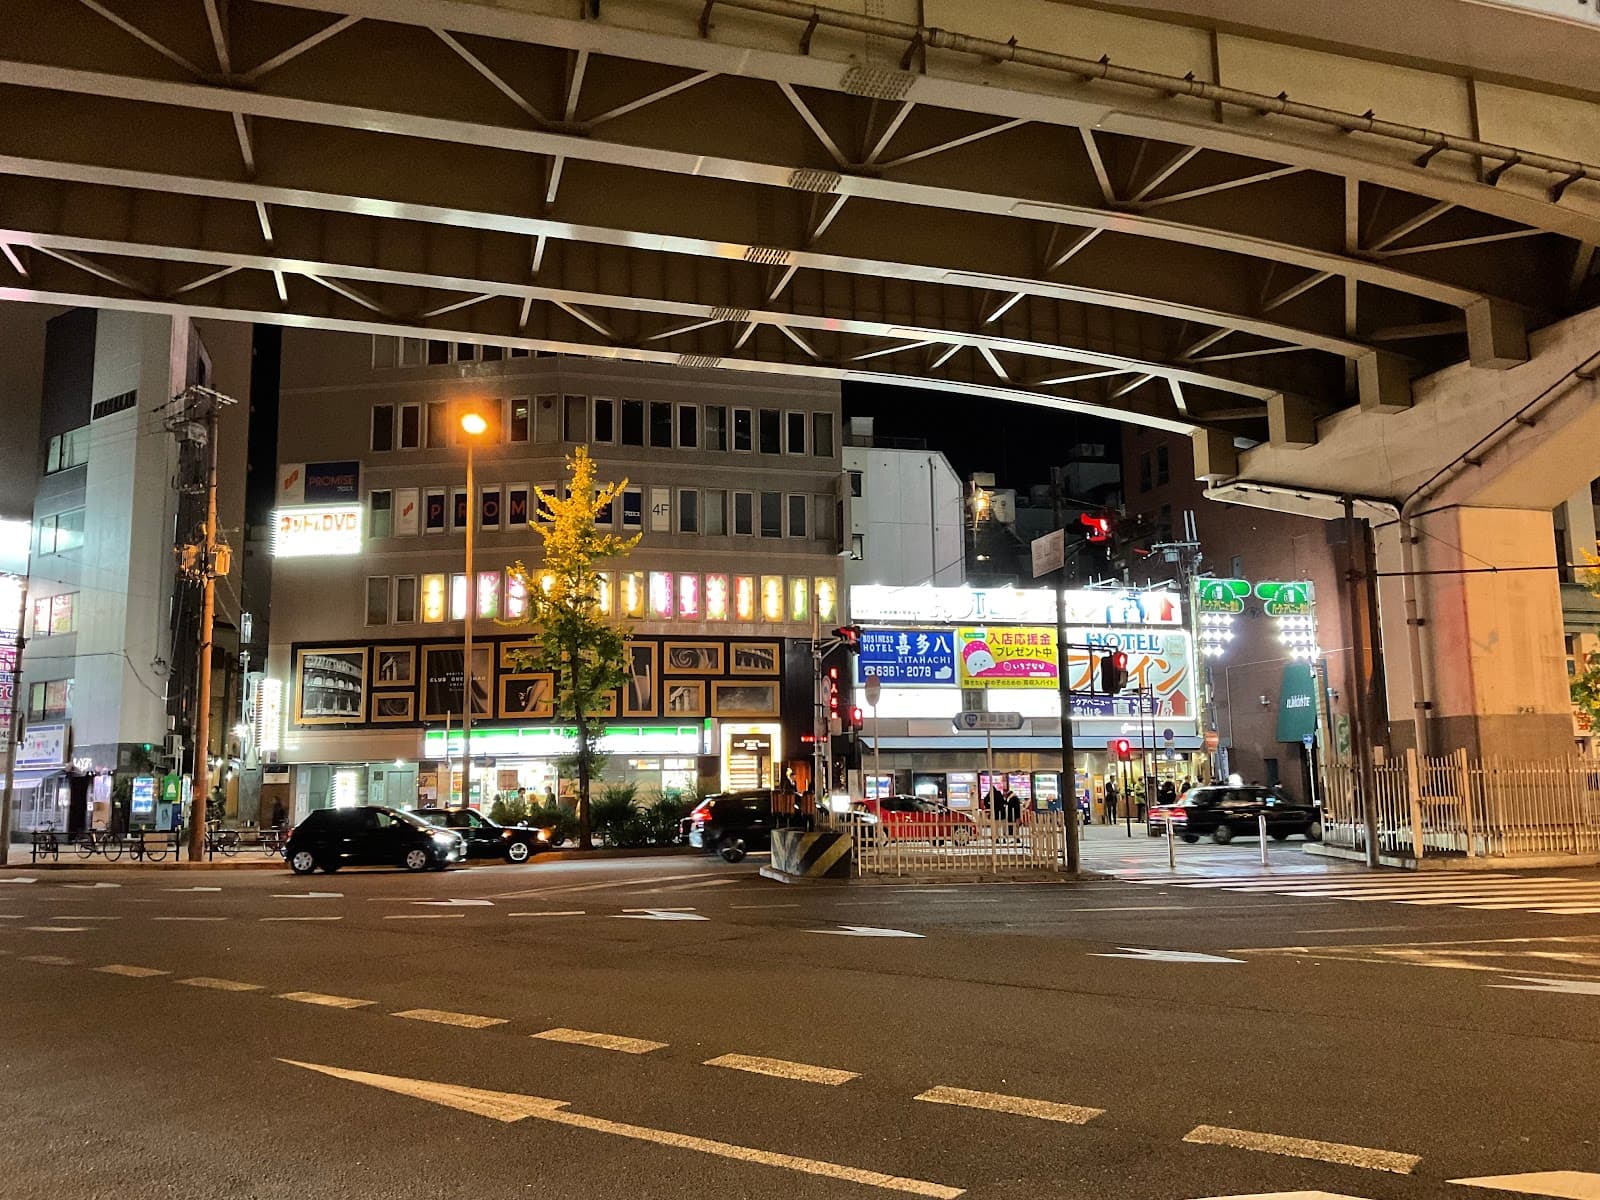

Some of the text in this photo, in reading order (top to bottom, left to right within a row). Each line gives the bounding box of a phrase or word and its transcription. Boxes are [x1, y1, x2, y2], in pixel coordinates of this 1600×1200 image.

[652, 503, 670, 516] 4F
[862, 635, 894, 643] BUSINESS
[896, 632, 951, 655] 喜多八
[989, 633, 1051, 646] 入店応援金
[1086, 632, 1163, 654] HOTEL
[863, 644, 894, 652] HOTEL
[996, 647, 1052, 657] プレゼント中
[898, 656, 951, 664] KITAHACHI
